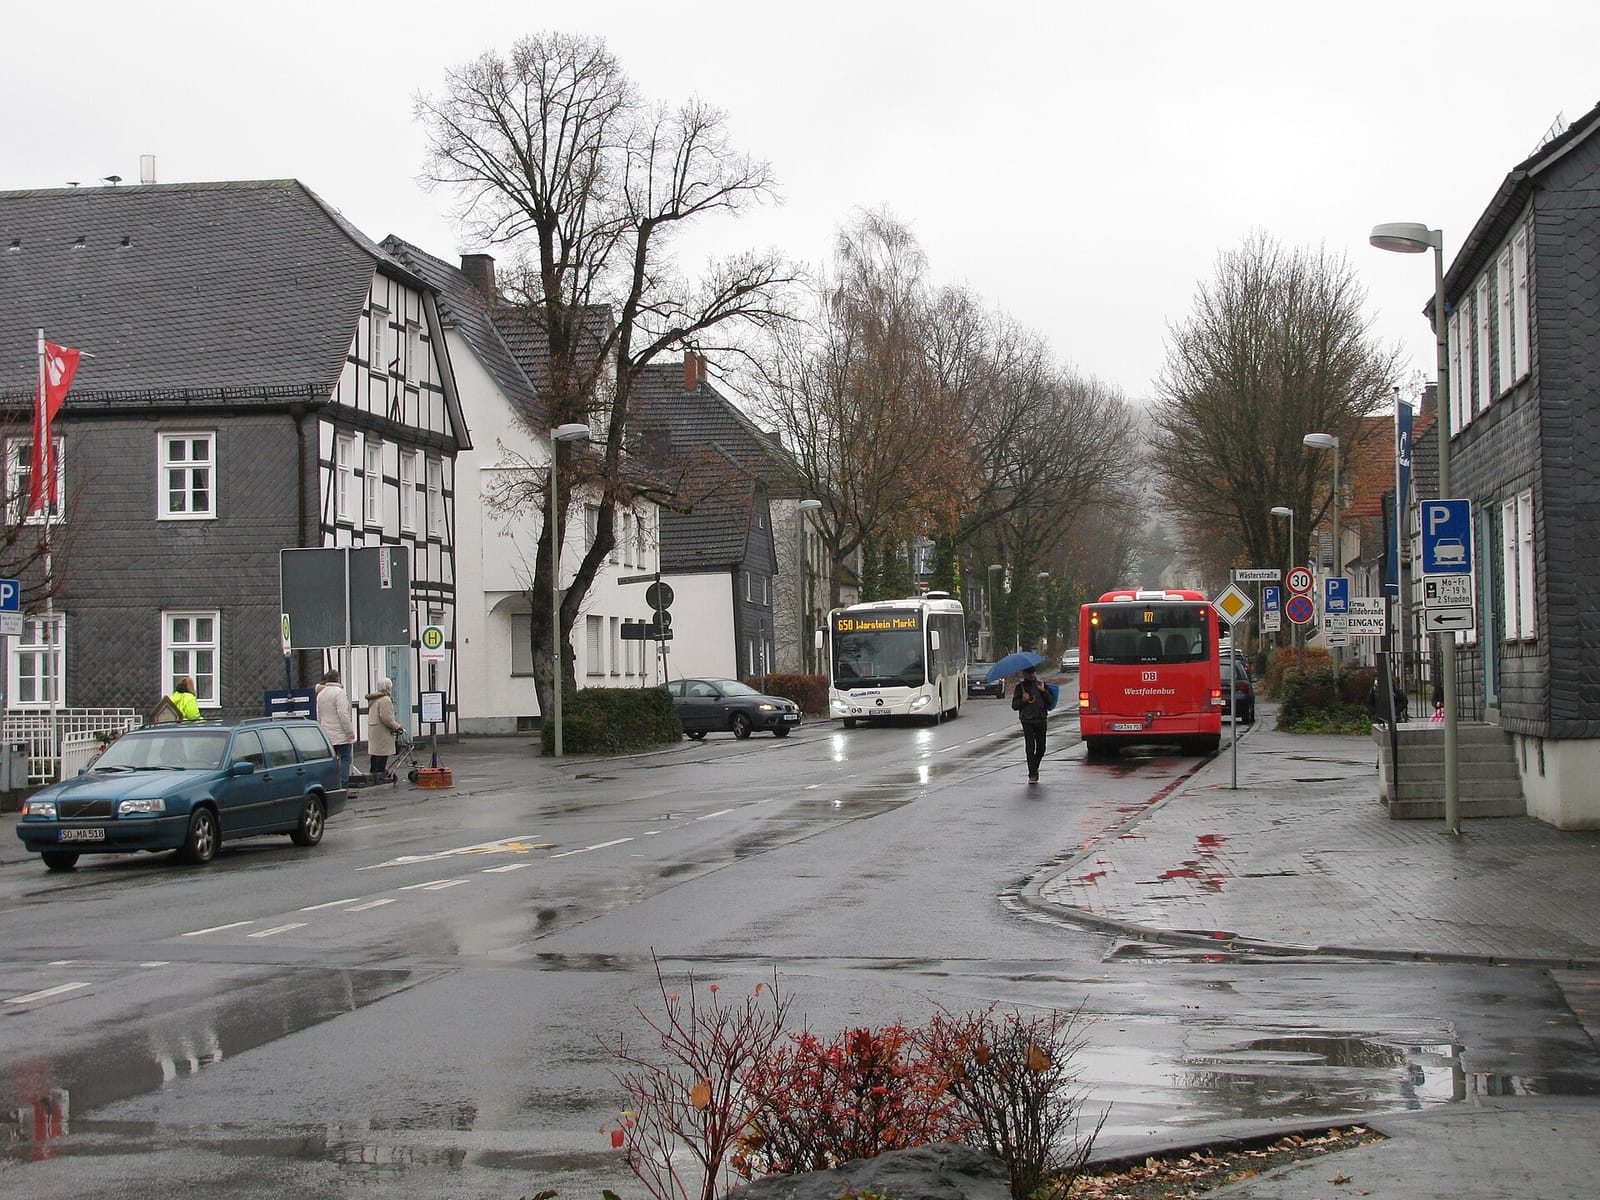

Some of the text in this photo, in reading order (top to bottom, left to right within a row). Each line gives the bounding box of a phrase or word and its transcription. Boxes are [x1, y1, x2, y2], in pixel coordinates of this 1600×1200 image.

[1429, 506, 1450, 536] P
[1292, 575, 1308, 587] 30
[1328, 581, 1339, 595] P
[0, 584, 14, 607] P
[1266, 589, 1273, 599] P
[1437, 595, 1470, 604] 2 Stunden
[838, 617, 916, 631] 650 Warstein Markt
[1348, 618, 1384, 627] EINGANG
[428, 632, 438, 645] H
[1143, 672, 1156, 681] DB
[1124, 688, 1175, 696] Westfalenbus
[62, 830, 73, 839] SO
[88, 829, 104, 838] 518
